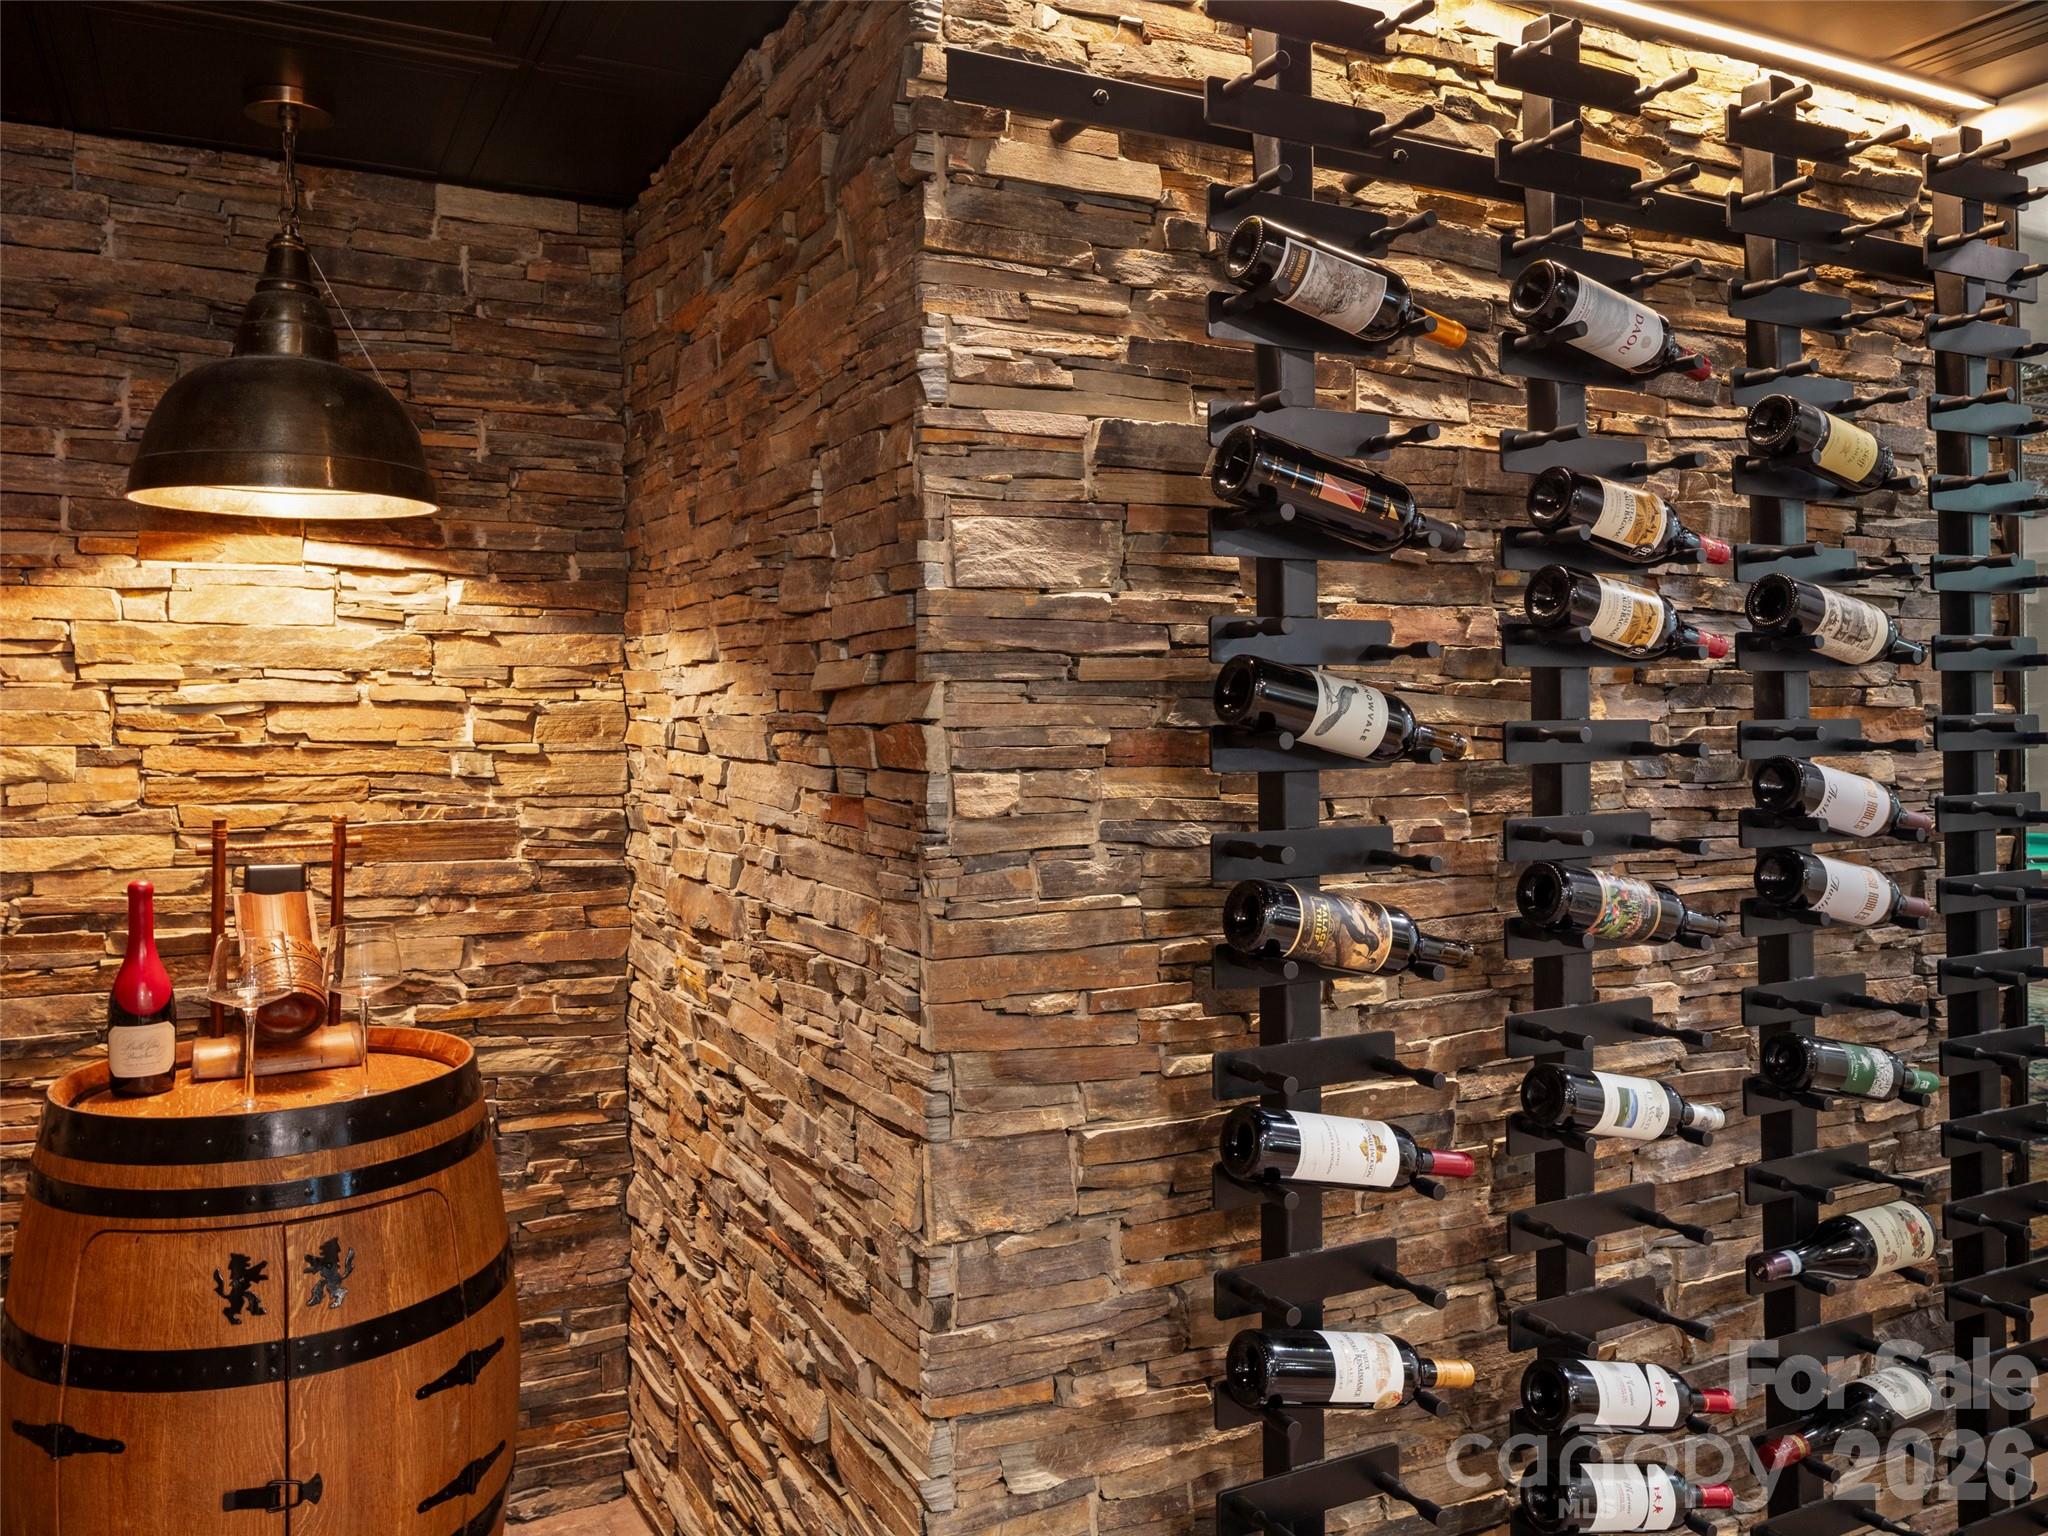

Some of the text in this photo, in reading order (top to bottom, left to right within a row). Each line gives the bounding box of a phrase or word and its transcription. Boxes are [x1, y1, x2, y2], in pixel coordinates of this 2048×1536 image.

[1619, 314, 1644, 355] DAOU
[1855, 801, 1877, 831] ROBLES
[1854, 892, 1878, 922] ROBLES
[1318, 904, 1329, 948] PALACE
